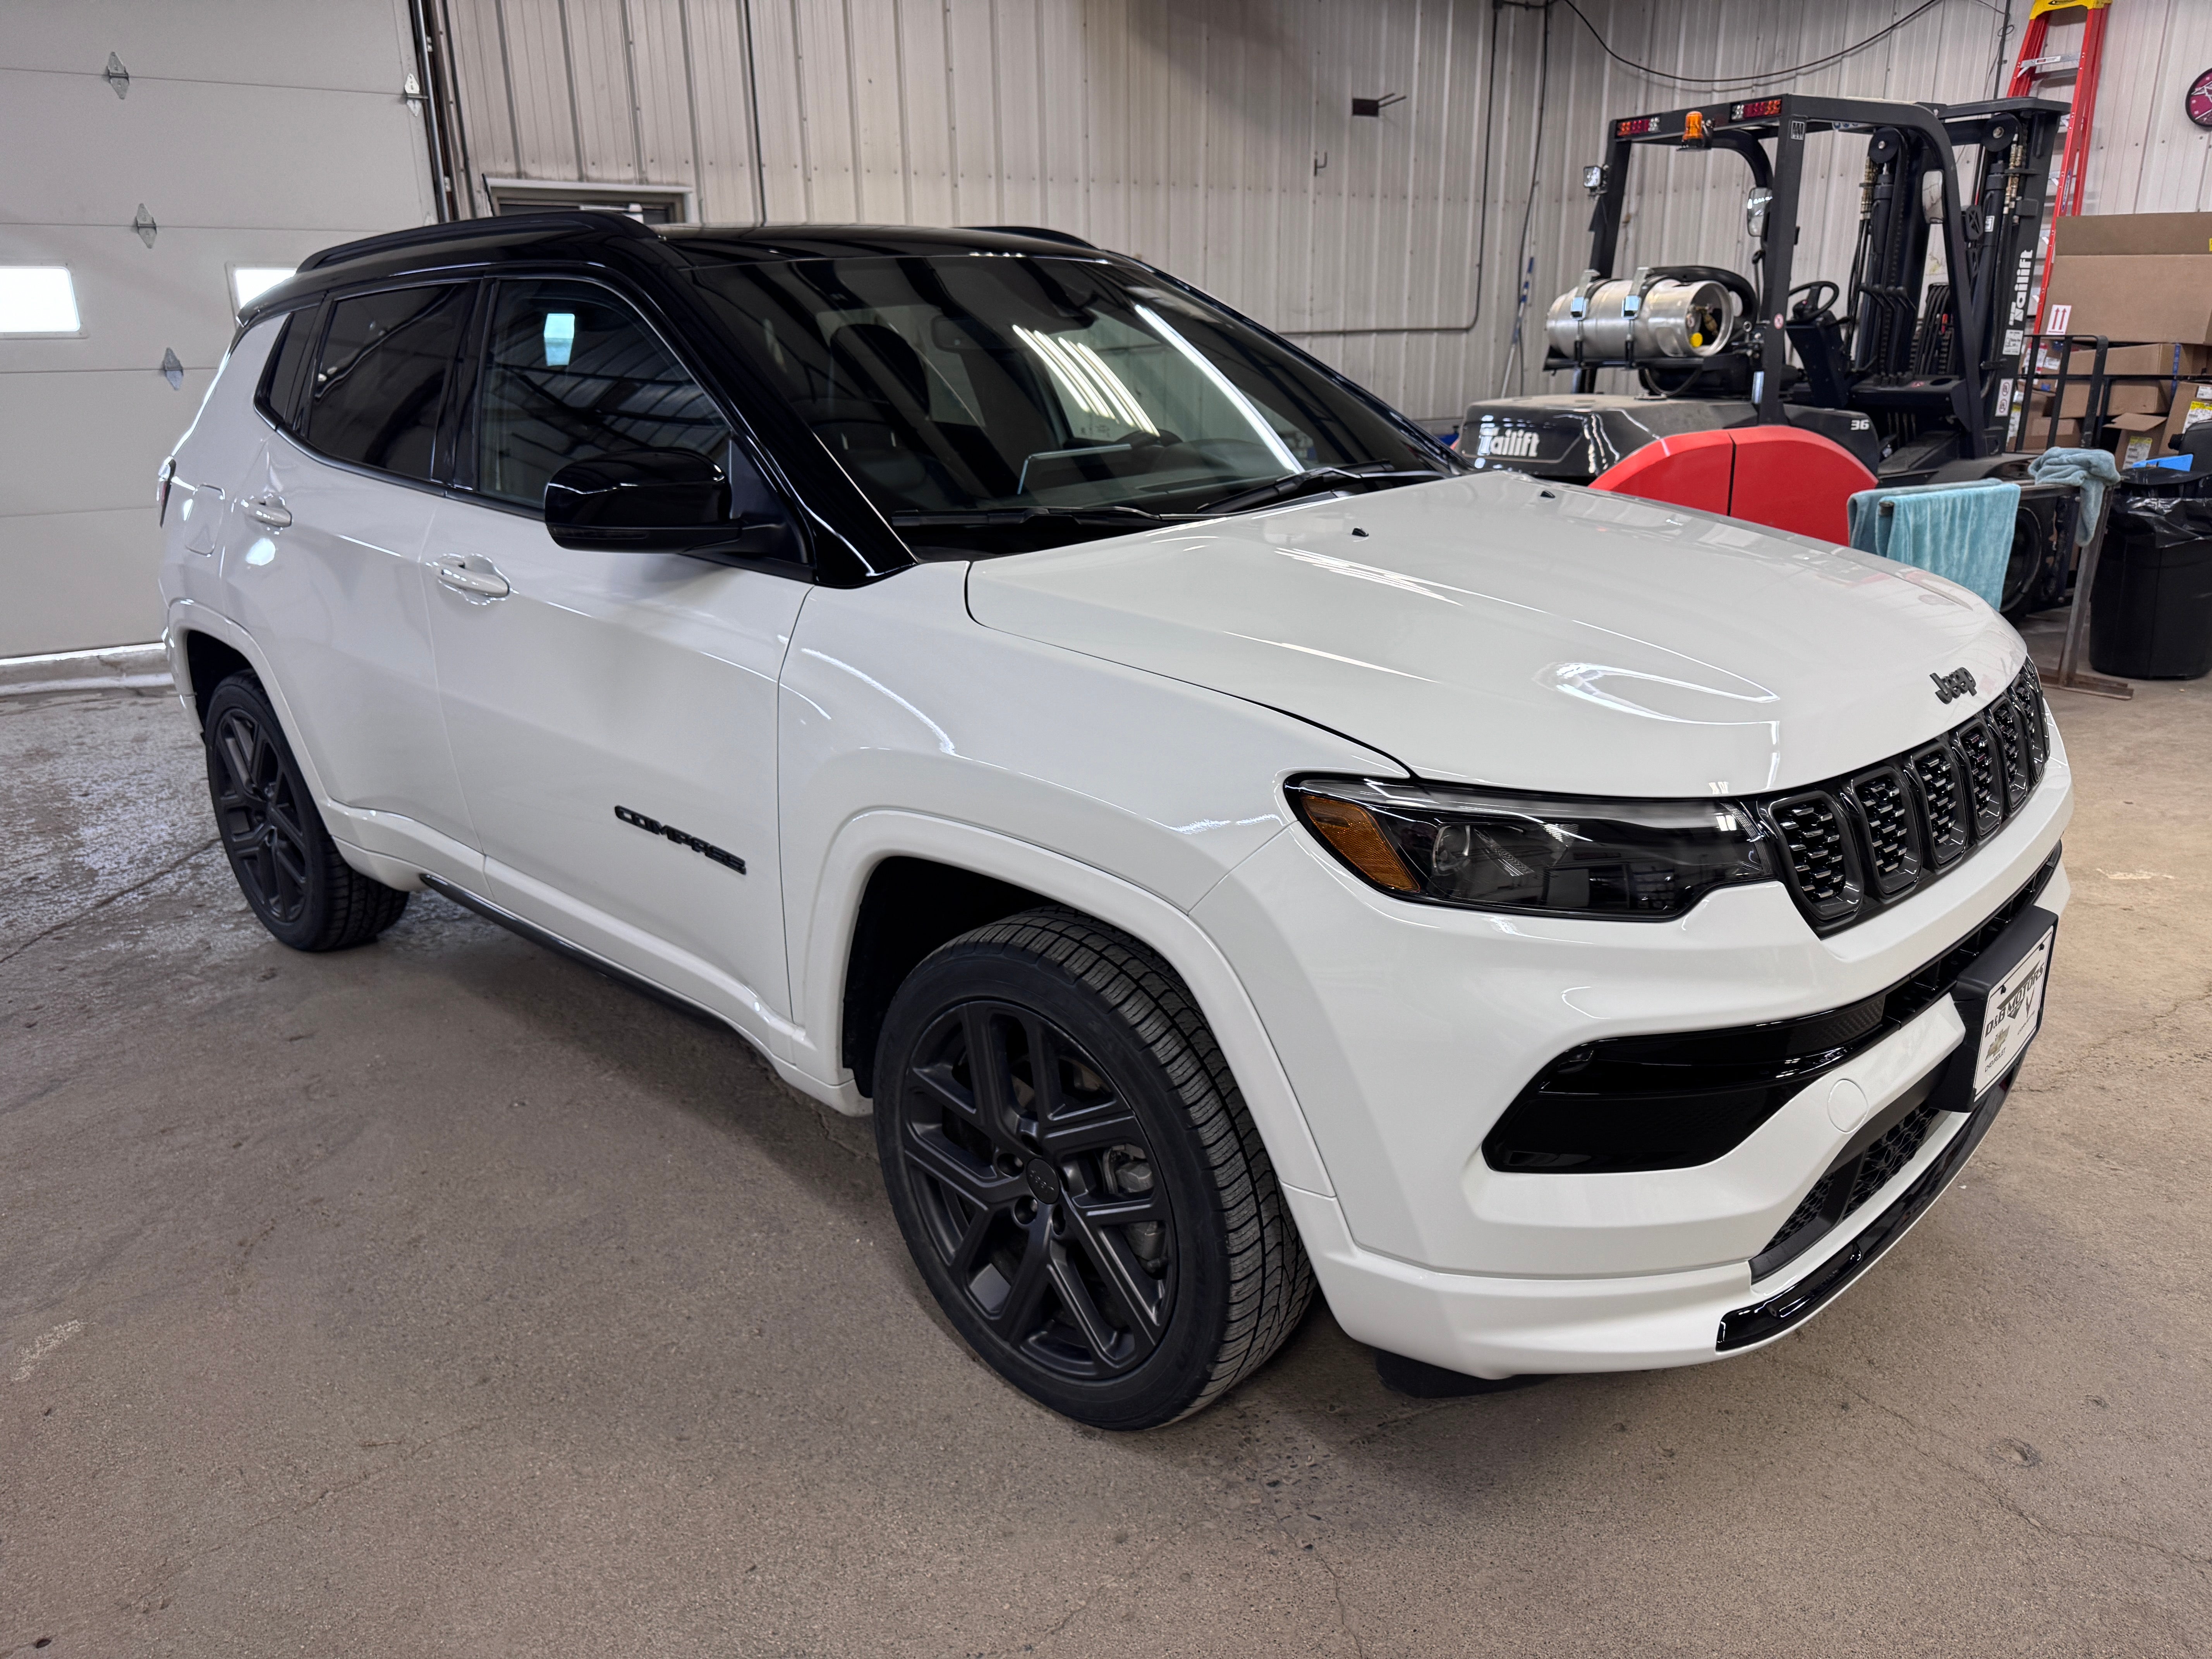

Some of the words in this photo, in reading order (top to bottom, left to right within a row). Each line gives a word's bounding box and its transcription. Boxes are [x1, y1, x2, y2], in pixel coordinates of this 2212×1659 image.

[2009, 249, 2033, 326] Tailift
[1478, 428, 1540, 457] Tailift
[1850, 419, 1870, 431] 36
[1929, 666, 1977, 704] Jeep
[614, 805, 747, 876] COMPASS
[1985, 1006, 2006, 1038] D&B
[2007, 962, 2045, 1015] MOTORS
[1985, 1047, 2006, 1072] CHEVROLET
